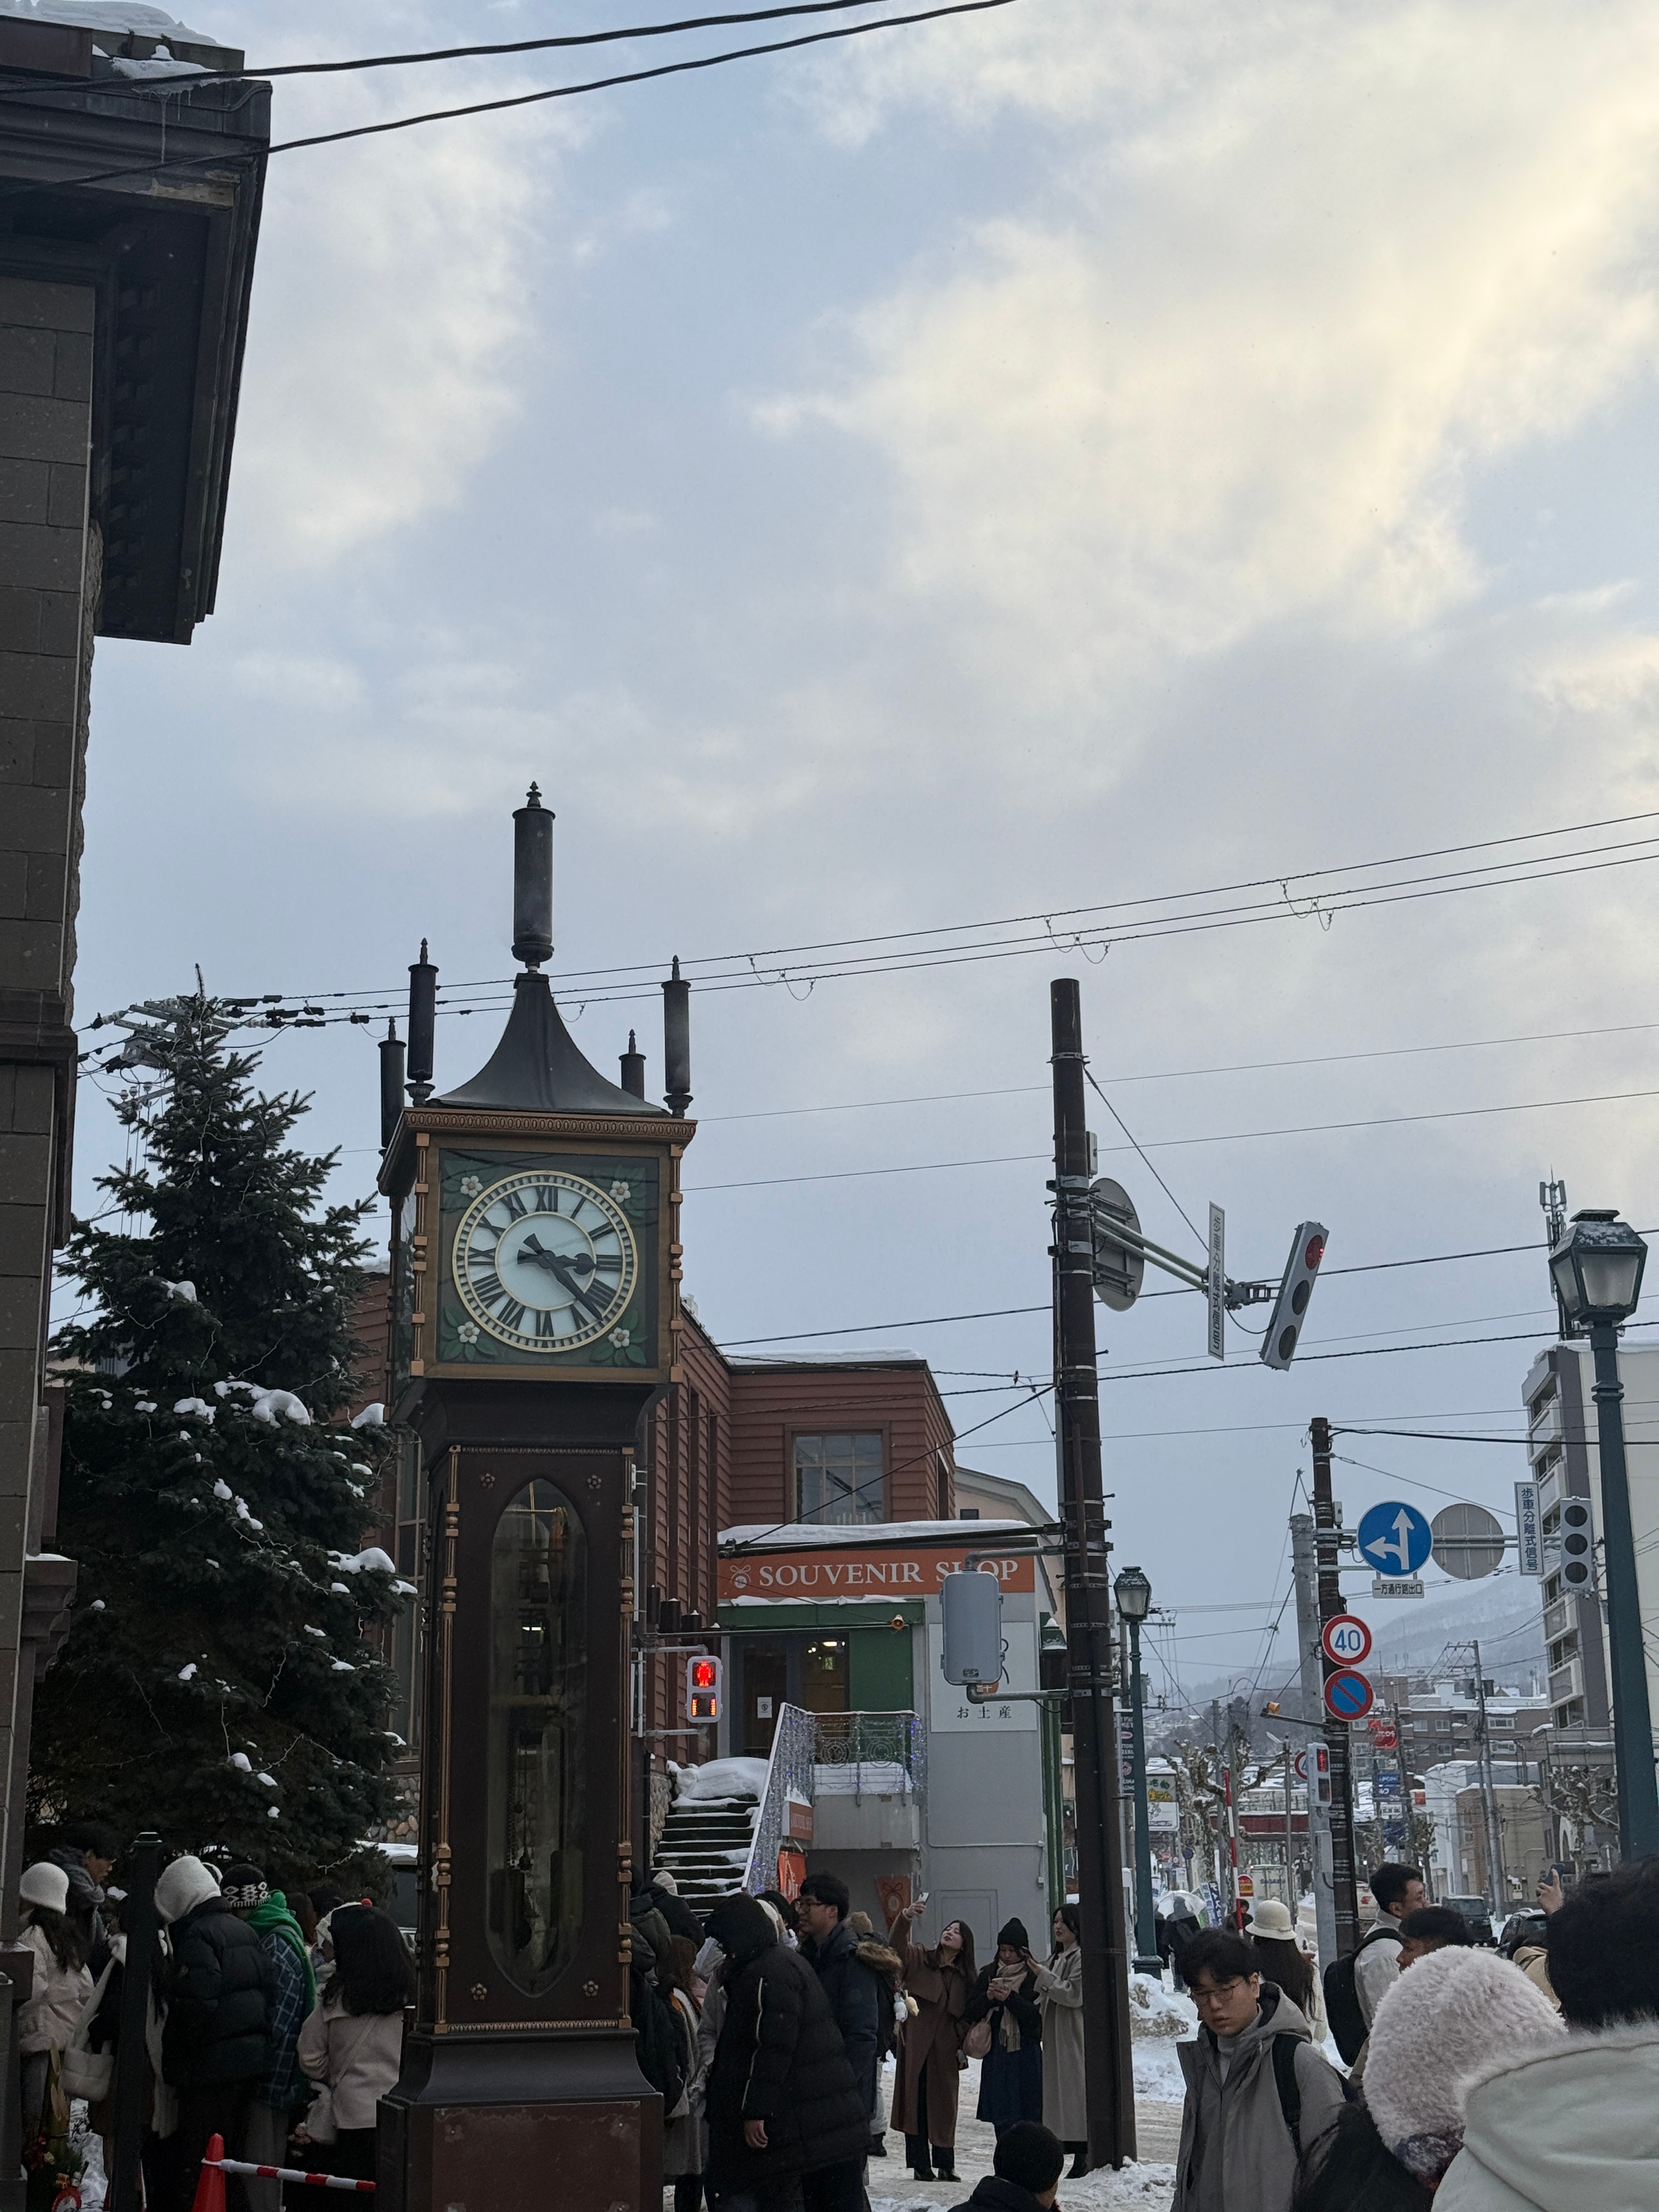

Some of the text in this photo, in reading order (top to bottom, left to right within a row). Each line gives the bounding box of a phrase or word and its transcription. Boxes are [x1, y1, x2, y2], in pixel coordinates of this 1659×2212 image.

[1521, 1487, 1538, 1571] 歩車分離式信号
[759, 1562, 925, 1587] SOUVENIR
[1374, 1583, 1423, 1595] 一方通行路出口
[1335, 1629, 1361, 1651] 40
[957, 1705, 1012, 1719] お土産
